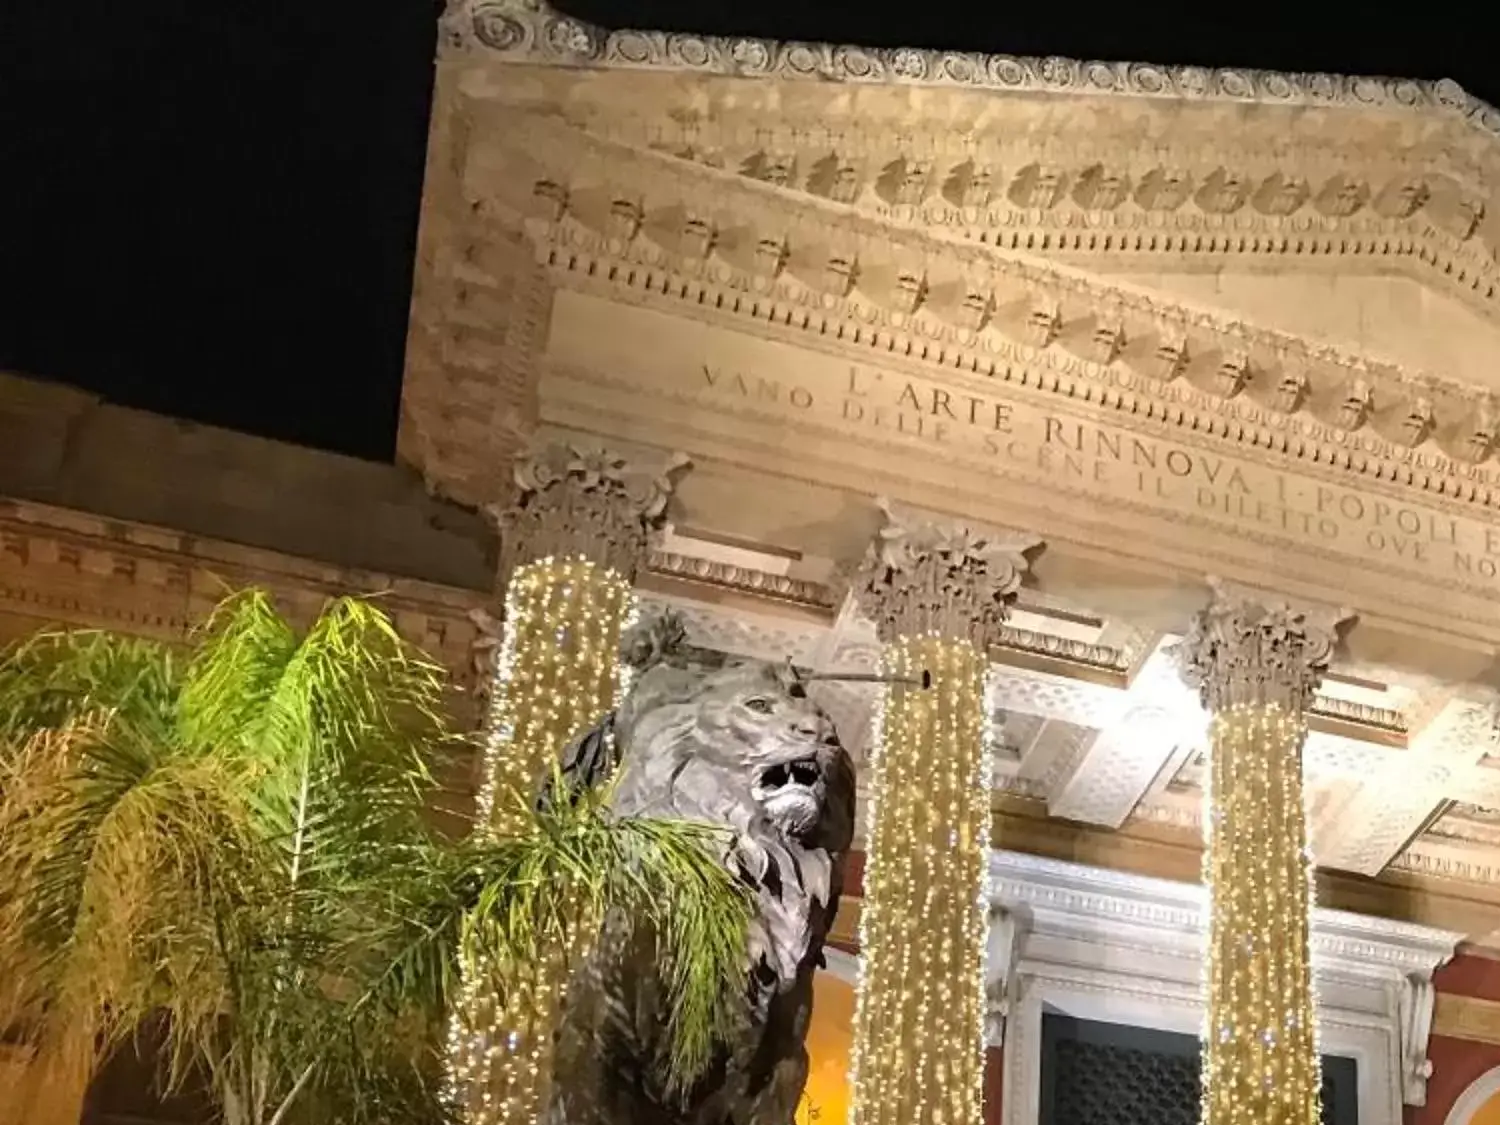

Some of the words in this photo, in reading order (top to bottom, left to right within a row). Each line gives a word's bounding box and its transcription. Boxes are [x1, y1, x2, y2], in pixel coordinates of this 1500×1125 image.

[702, 364, 814, 409] VANO
[842, 399, 950, 442] DELLE
[984, 433, 1108, 482] SCENE
[1138, 471, 1167, 497] IL
[1197, 486, 1339, 539] DILETTO
[1366, 529, 1430, 562] OVE
[1043, 416, 1252, 495] RINNOVA
[1316, 486, 1457, 545] POPOLI
